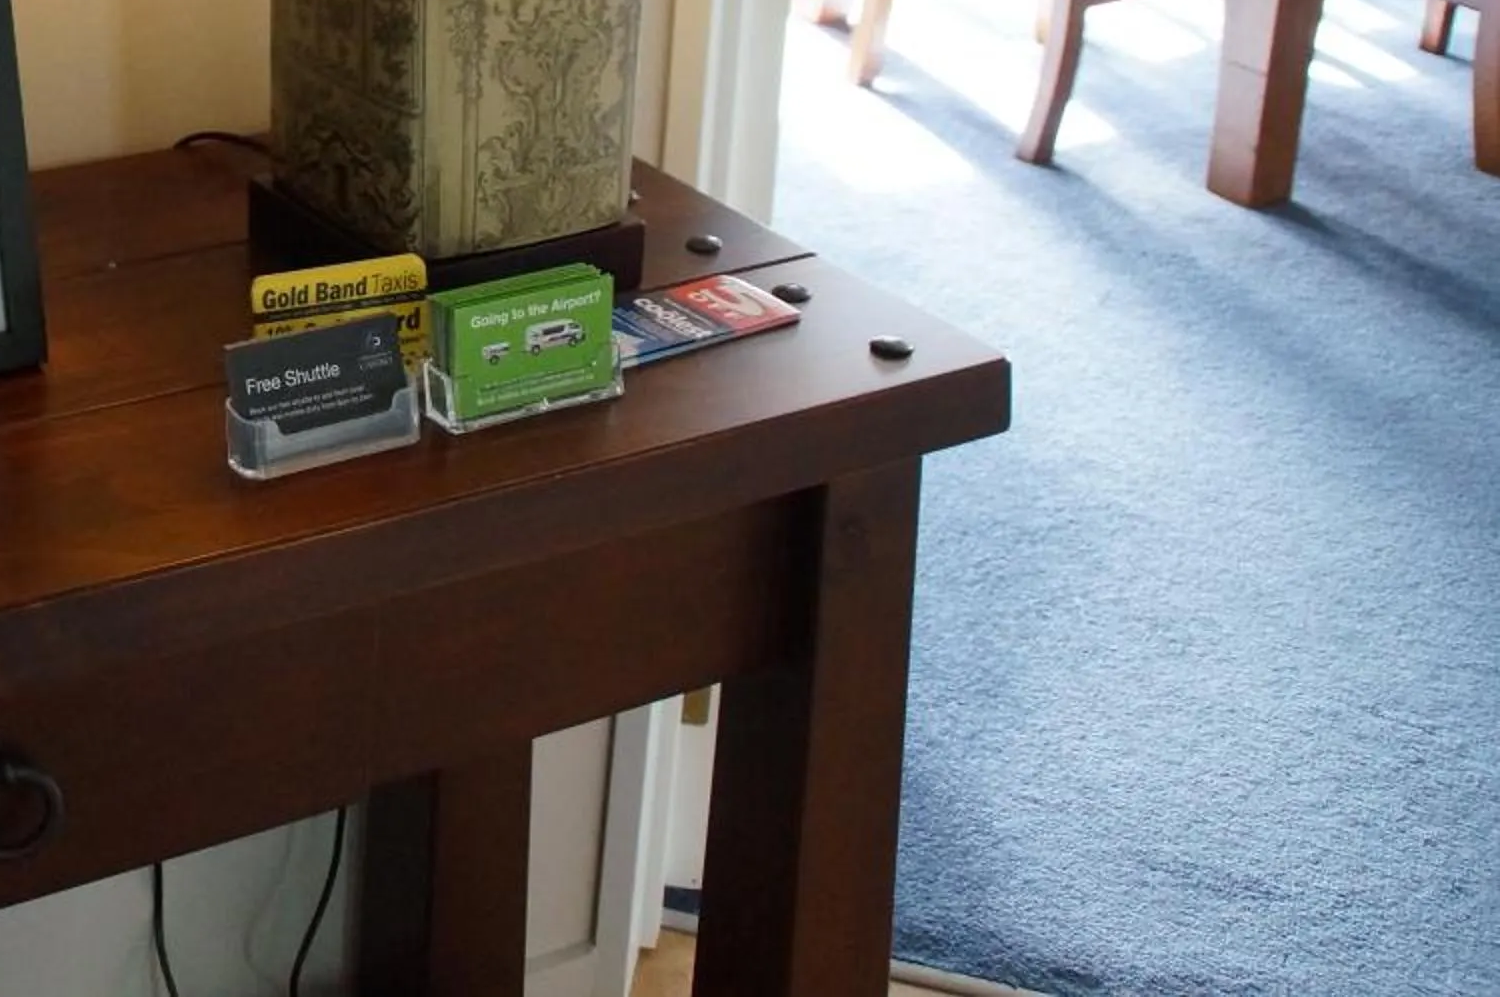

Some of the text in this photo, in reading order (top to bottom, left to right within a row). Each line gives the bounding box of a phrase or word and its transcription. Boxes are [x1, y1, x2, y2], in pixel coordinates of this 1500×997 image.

[262, 284, 309, 310] Gold
[315, 275, 367, 302] Band
[371, 270, 419, 295] Taxis
[470, 289, 602, 329] Going to the Airport?
[246, 362, 341, 396] Free Shuttle
